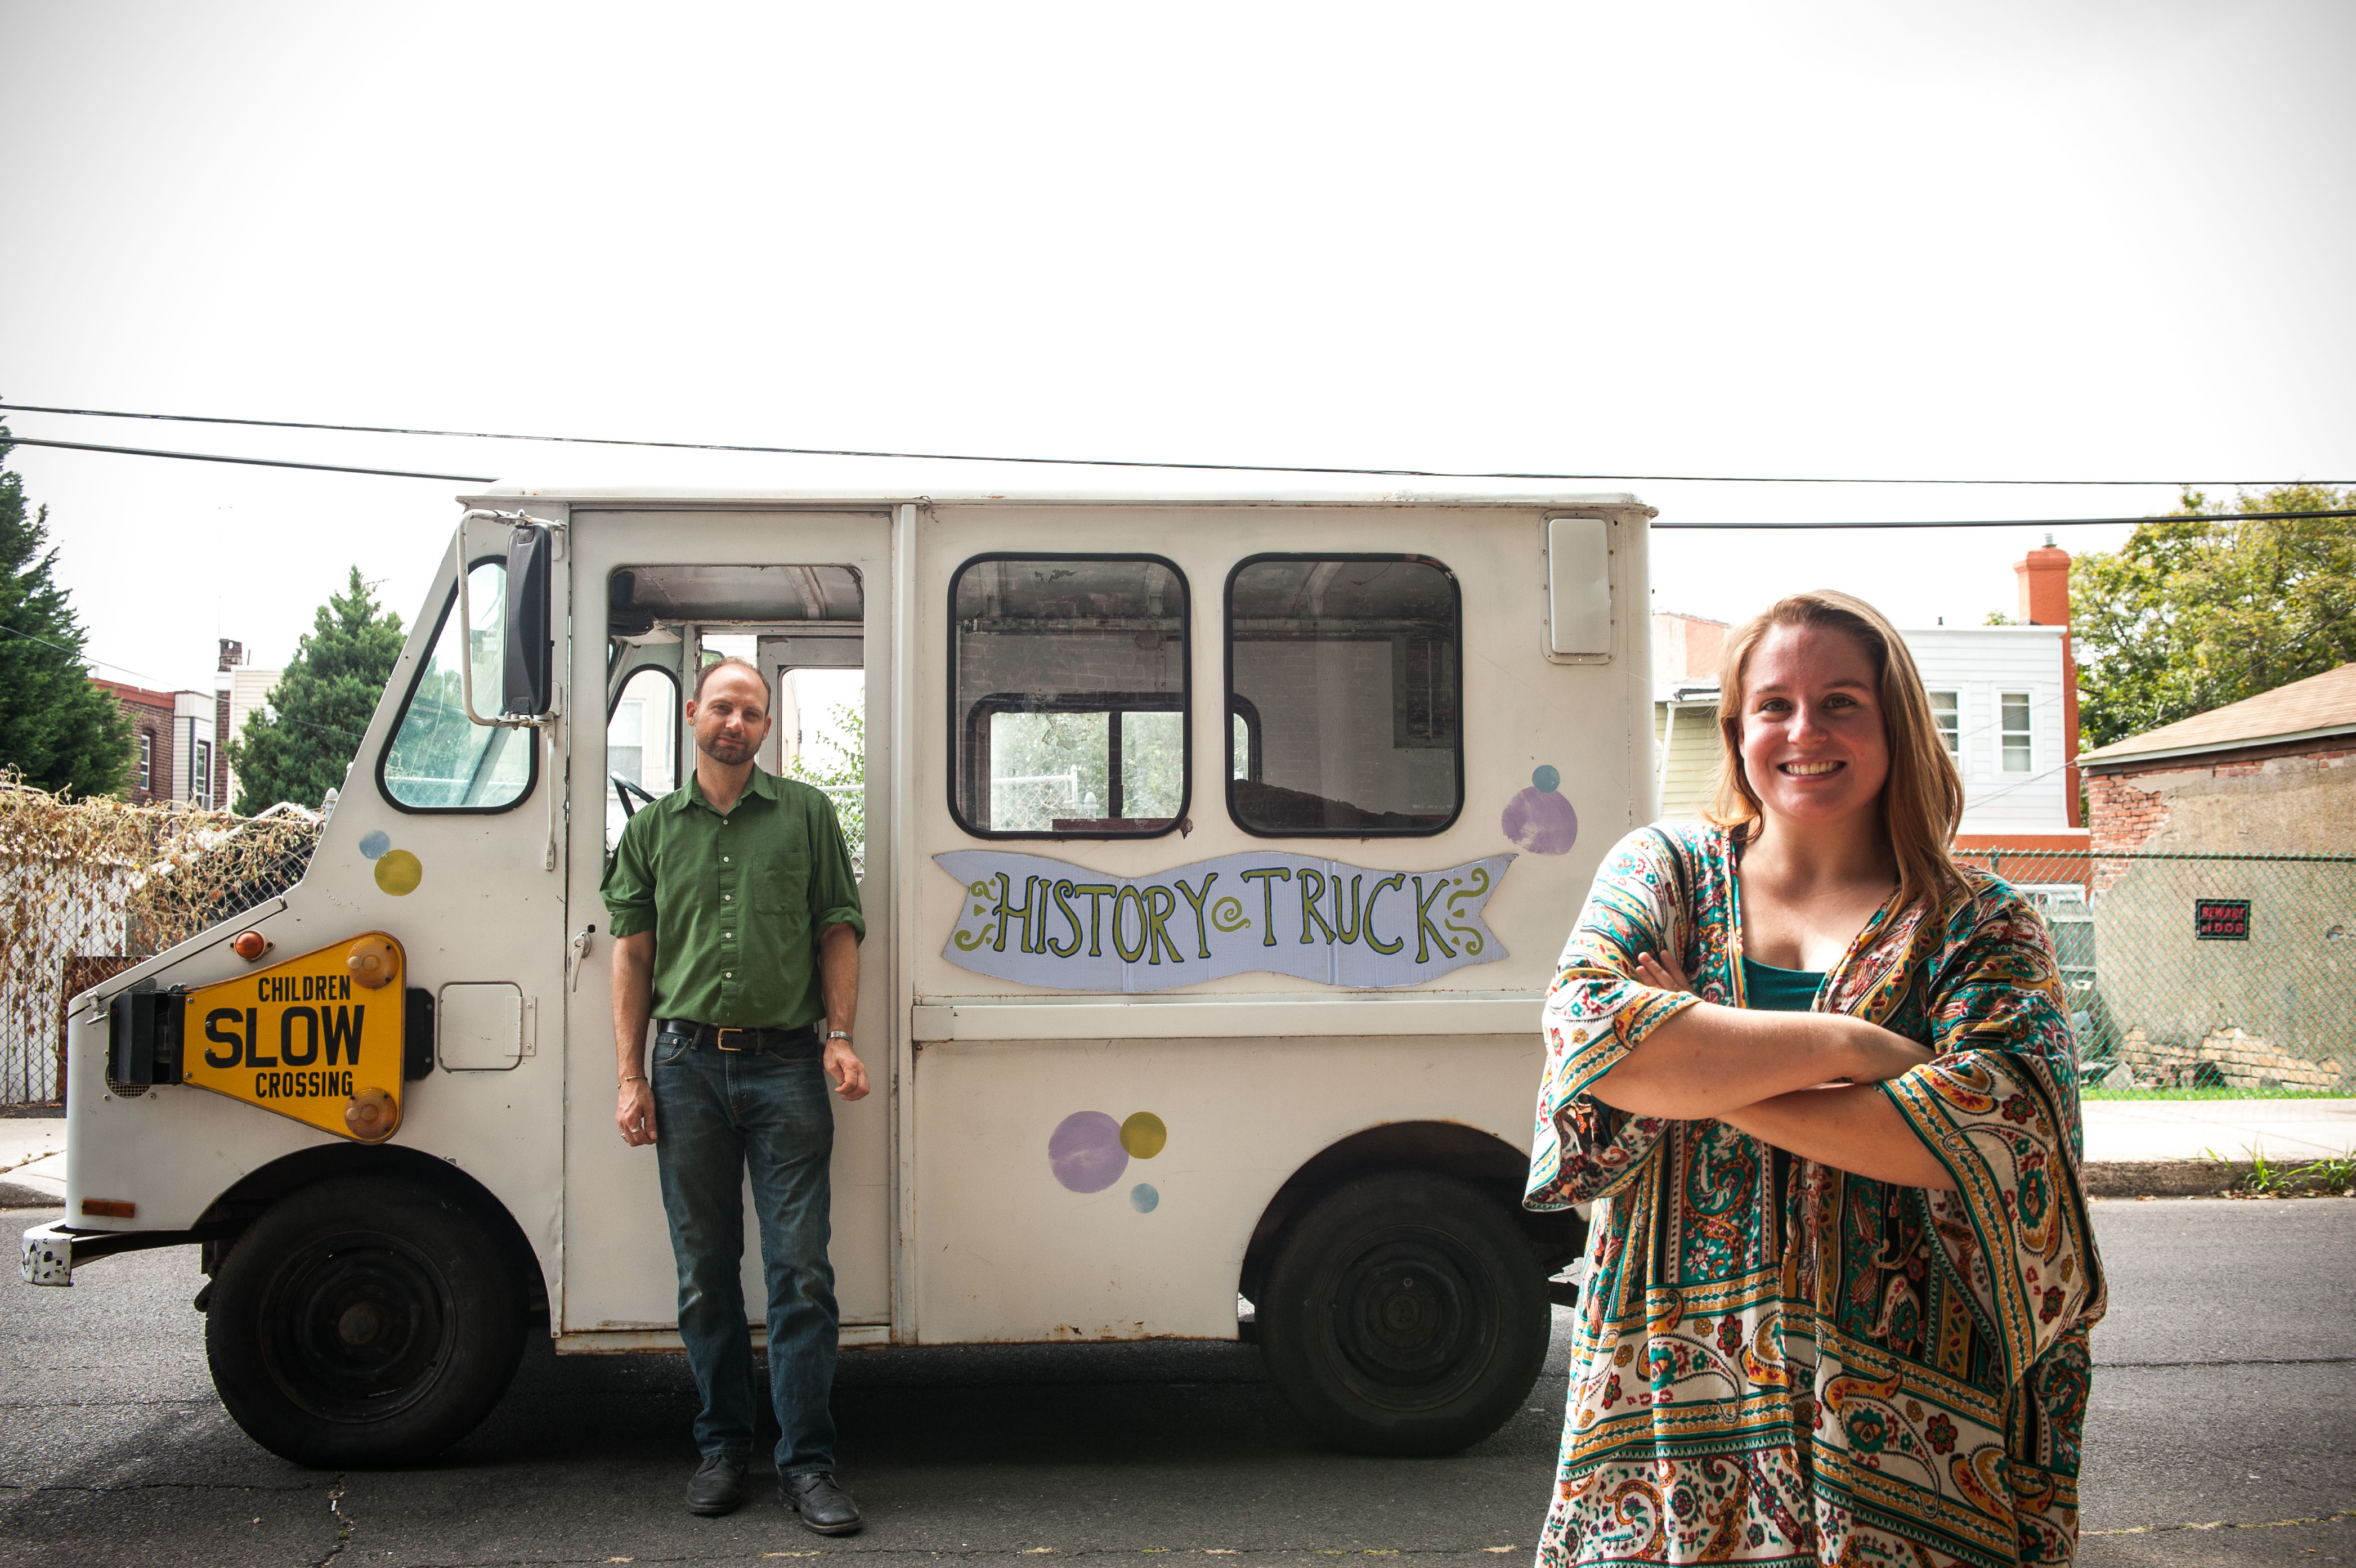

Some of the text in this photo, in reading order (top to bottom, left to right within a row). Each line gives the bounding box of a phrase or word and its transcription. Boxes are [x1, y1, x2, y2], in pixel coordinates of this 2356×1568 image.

[992, 867, 1457, 965] HISTORY TRUCK
[2202, 907, 2245, 918] BEWARE
[2201, 922, 2245, 933] of DOG
[258, 975, 351, 1002] CHILDREN
[204, 1004, 365, 1069] SLOW
[255, 1071, 353, 1098] CROSSING
